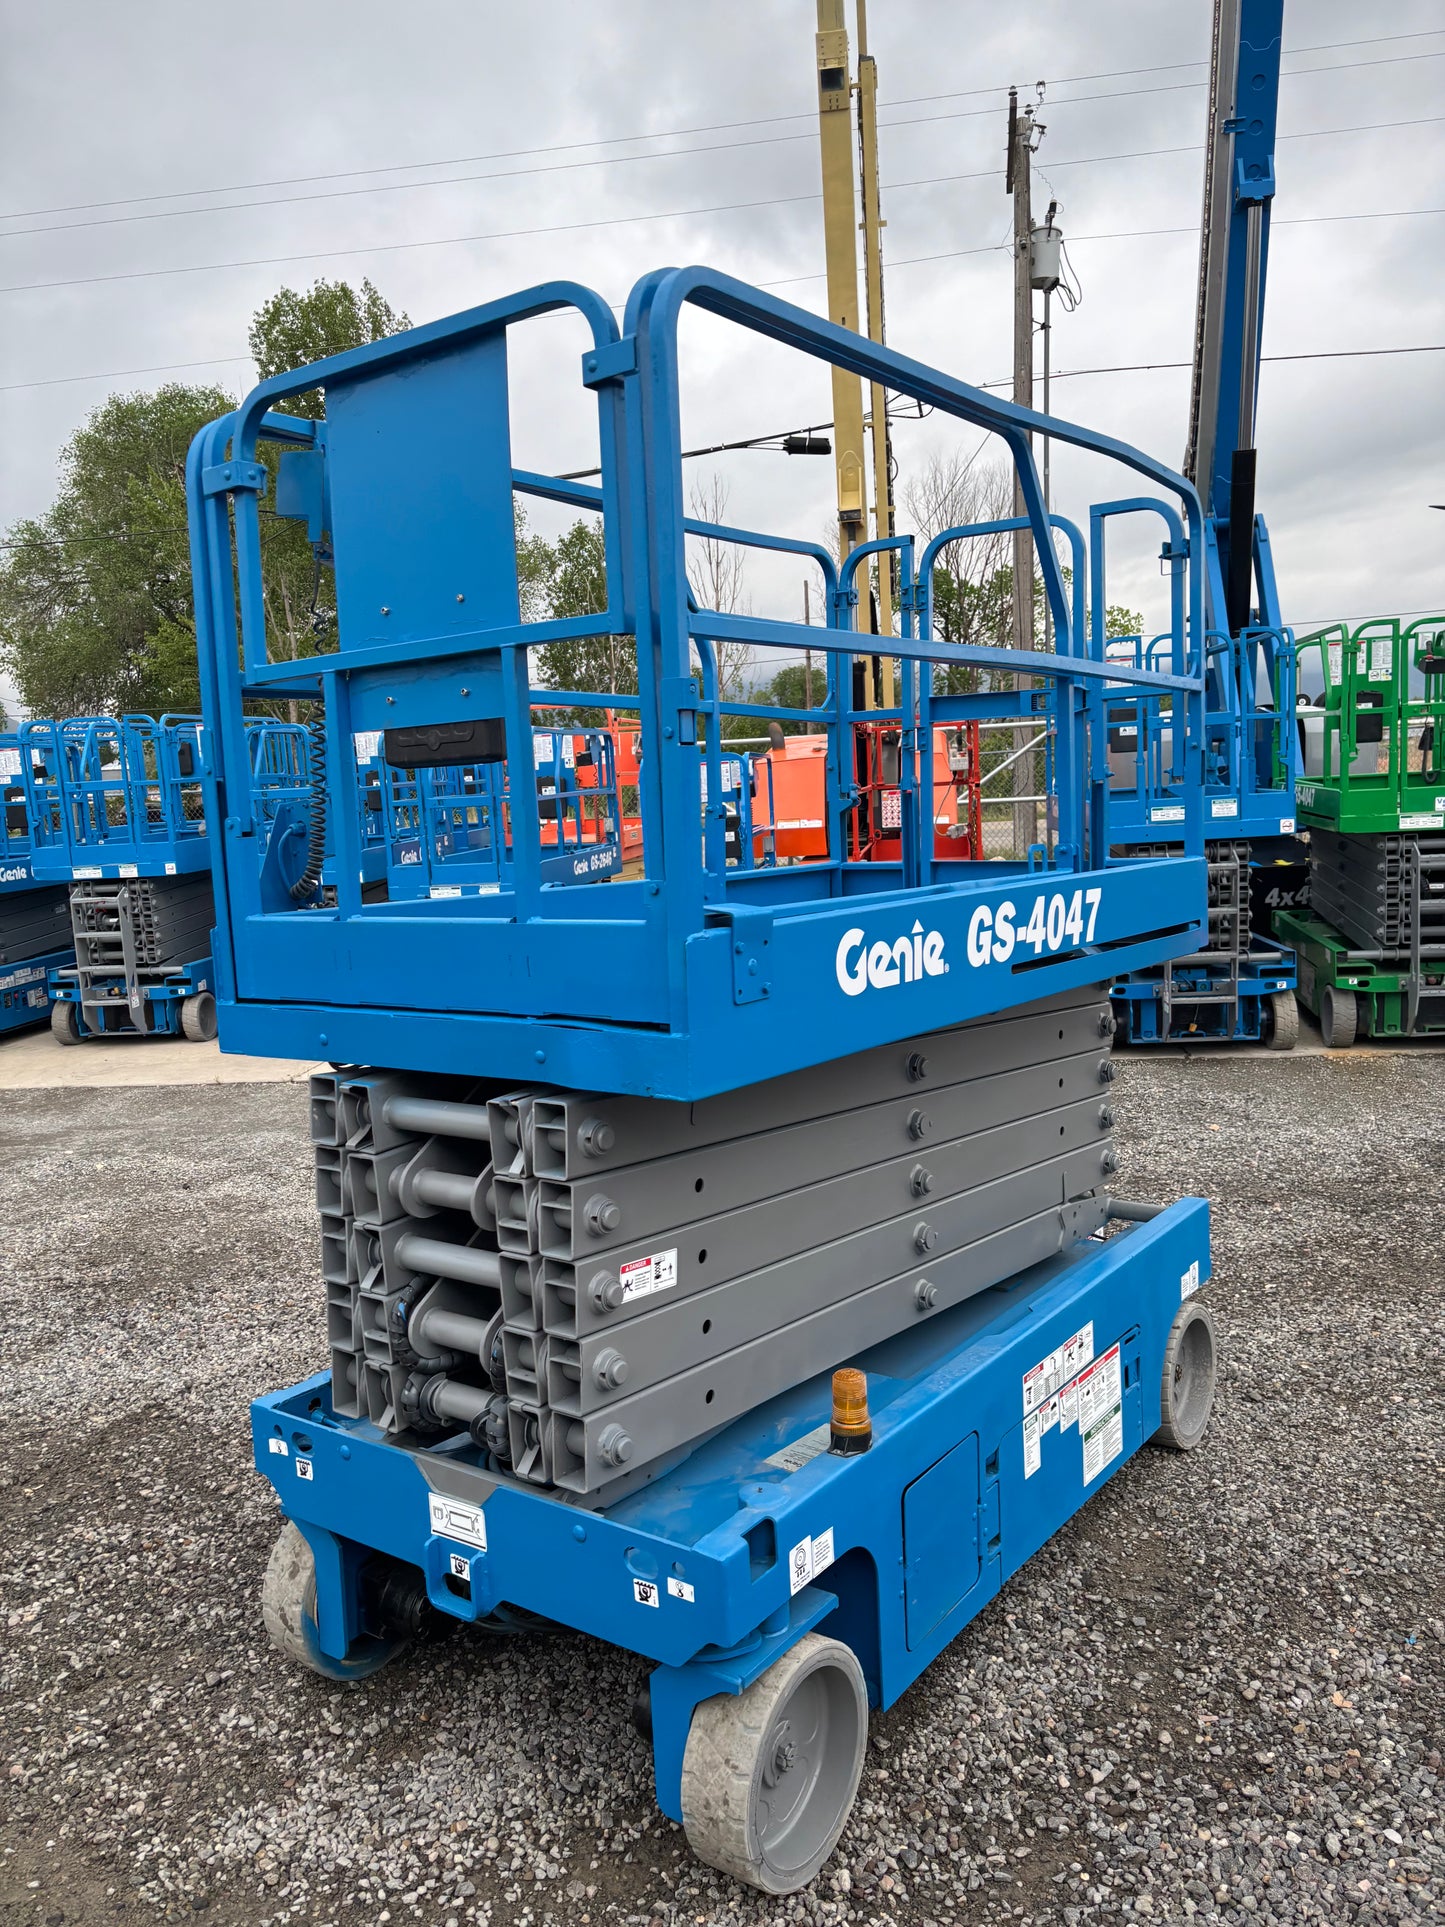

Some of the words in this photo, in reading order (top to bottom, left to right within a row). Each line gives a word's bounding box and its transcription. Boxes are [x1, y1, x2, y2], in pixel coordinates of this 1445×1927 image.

[0, 866, 28, 883] Genie
[836, 919, 947, 997] Genie
[967, 888, 1102, 968] GS-4047
[629, 1260, 648, 1272] DANGER
